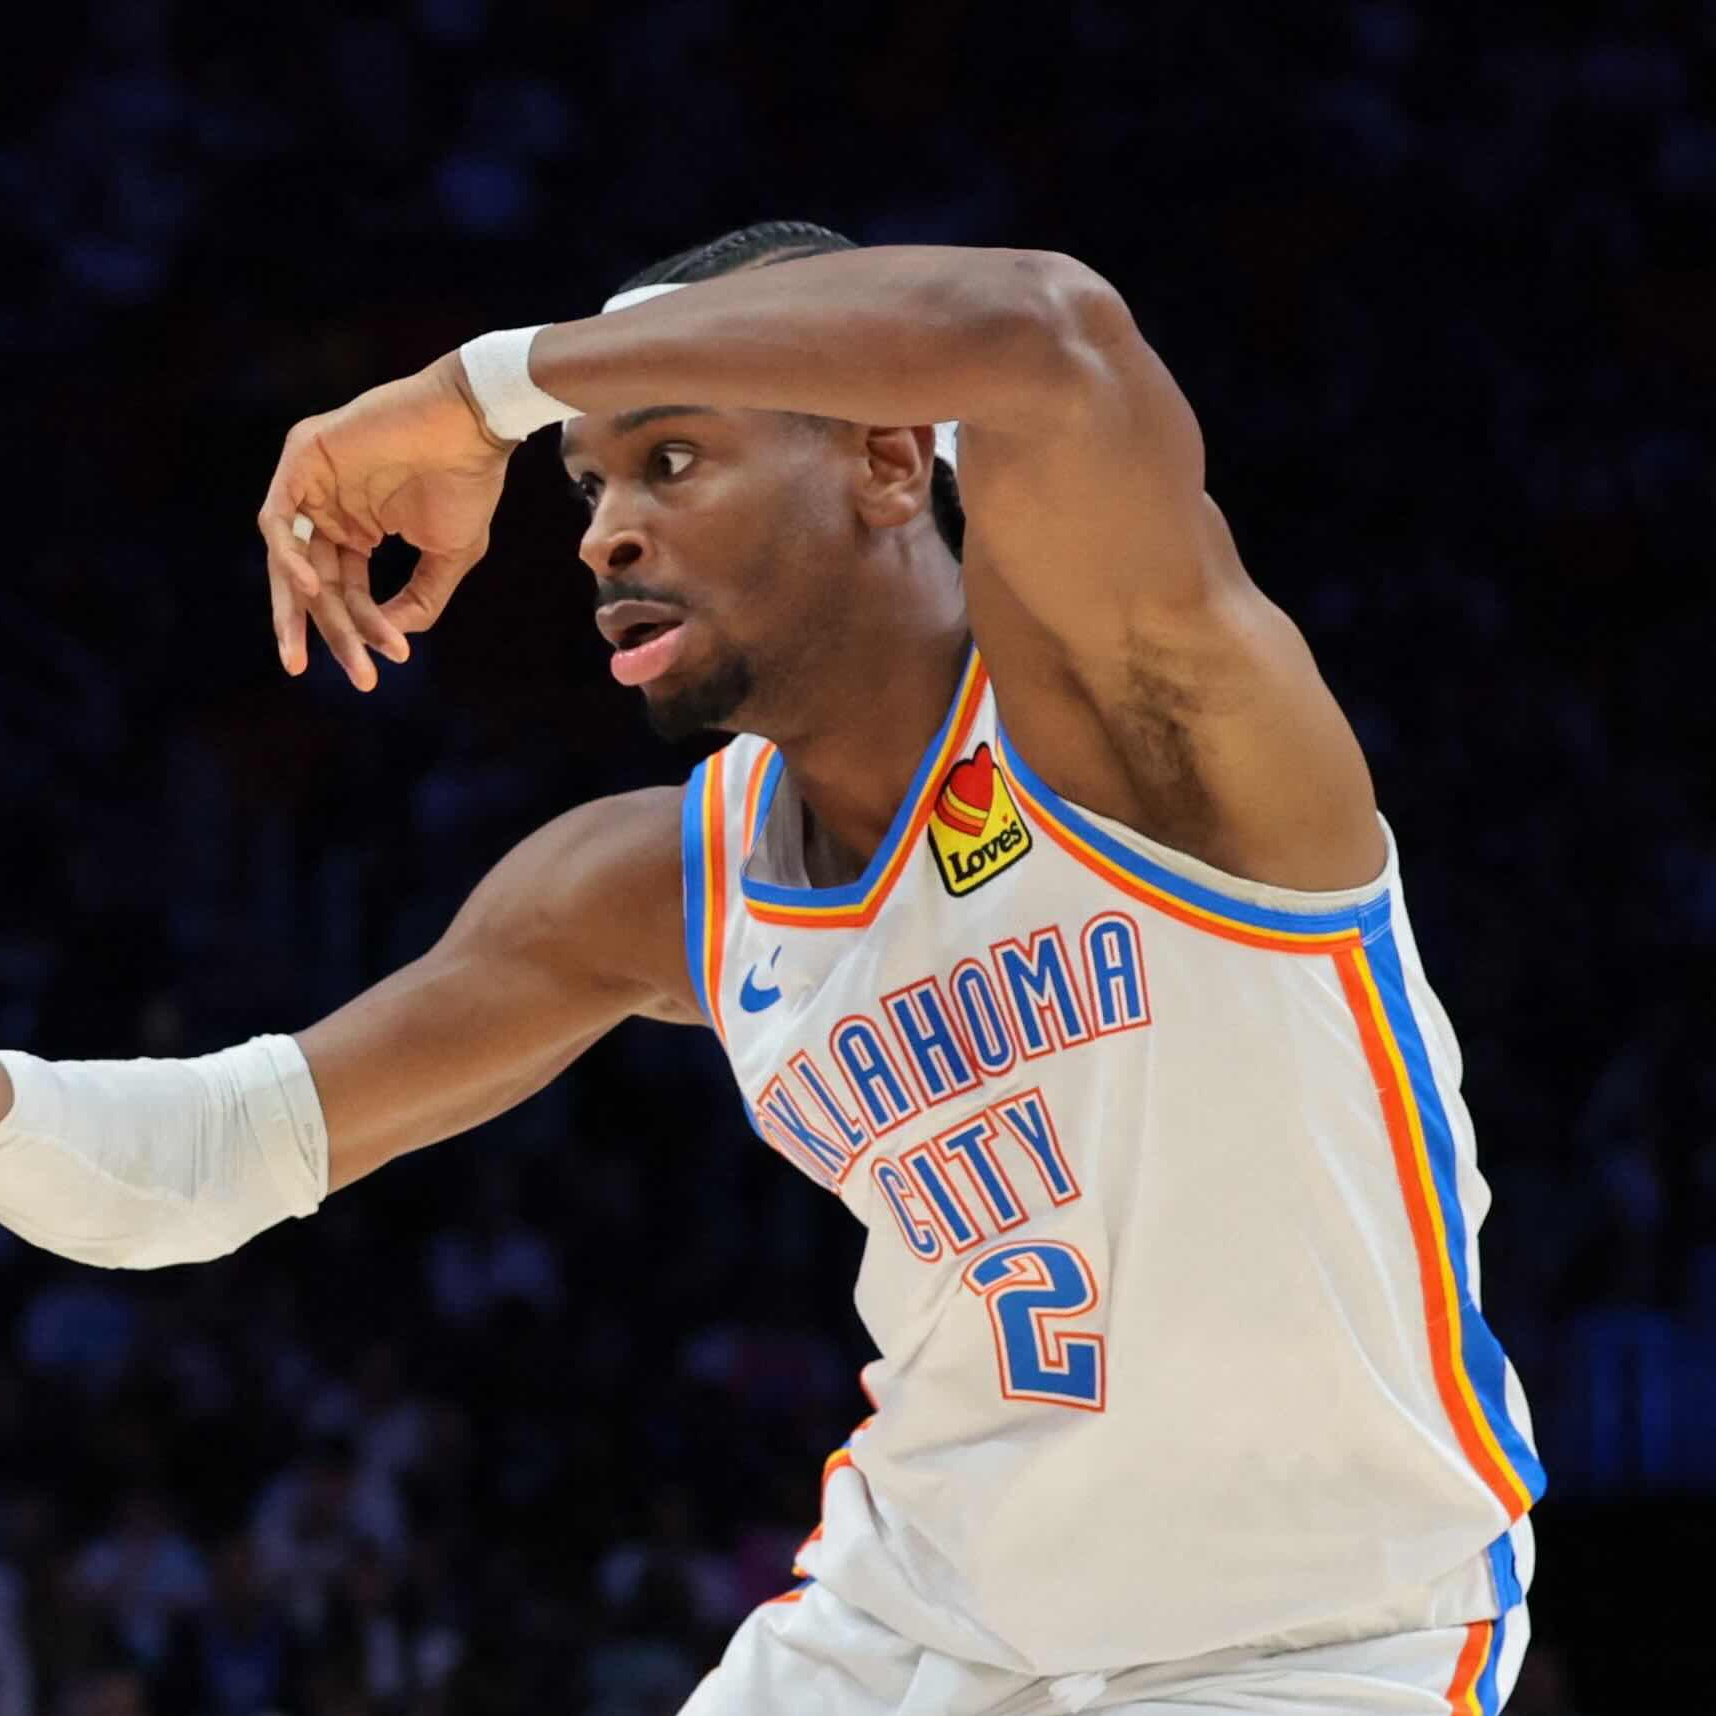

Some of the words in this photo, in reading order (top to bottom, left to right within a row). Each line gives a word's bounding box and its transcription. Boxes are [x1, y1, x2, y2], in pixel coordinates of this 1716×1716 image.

[756, 911, 1151, 1196] KLAHOMA
[871, 1087, 1081, 1262] CITY
[961, 1239, 1105, 1413] 2
